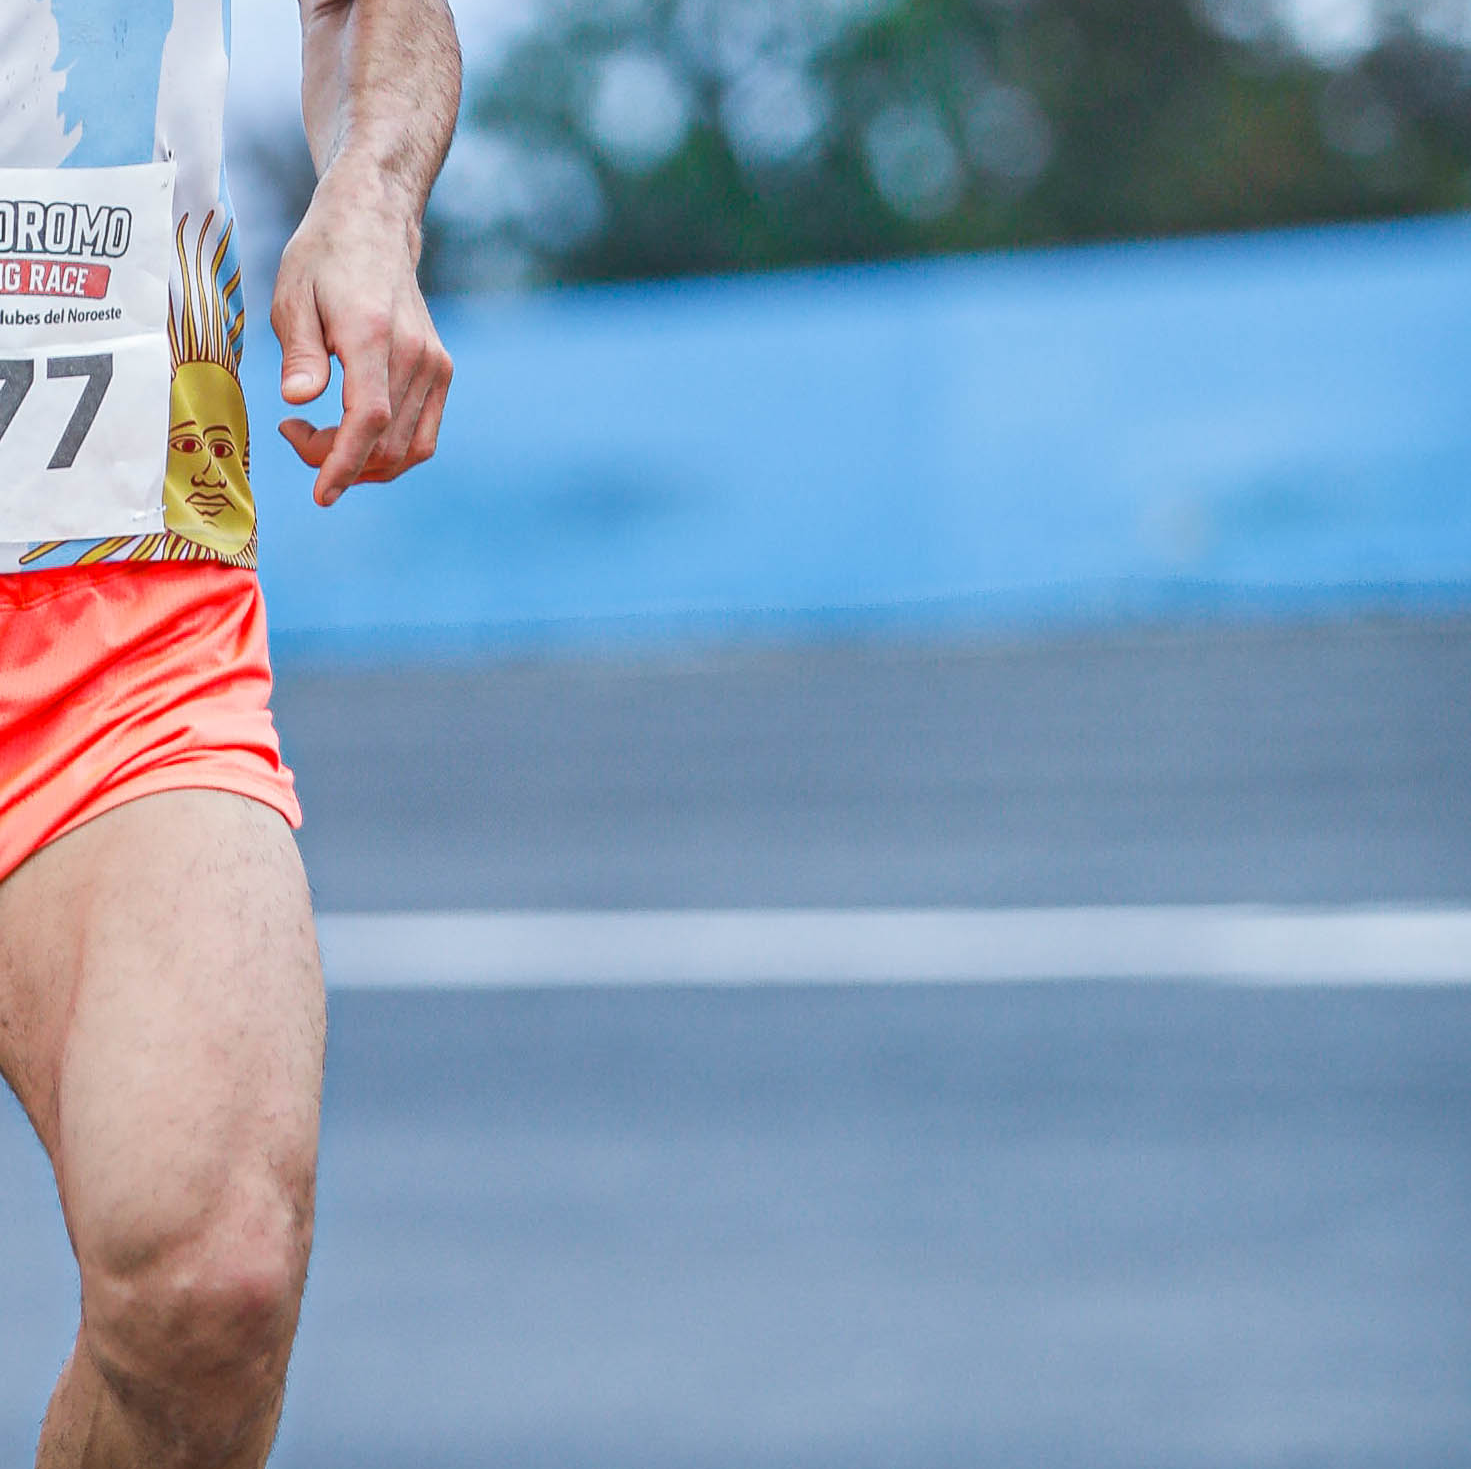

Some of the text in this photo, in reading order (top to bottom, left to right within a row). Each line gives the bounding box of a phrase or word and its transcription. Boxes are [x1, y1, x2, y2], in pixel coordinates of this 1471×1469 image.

[29, 264, 89, 295] RACE
[44, 308, 65, 324] del
[68, 306, 122, 323] Noroeste
